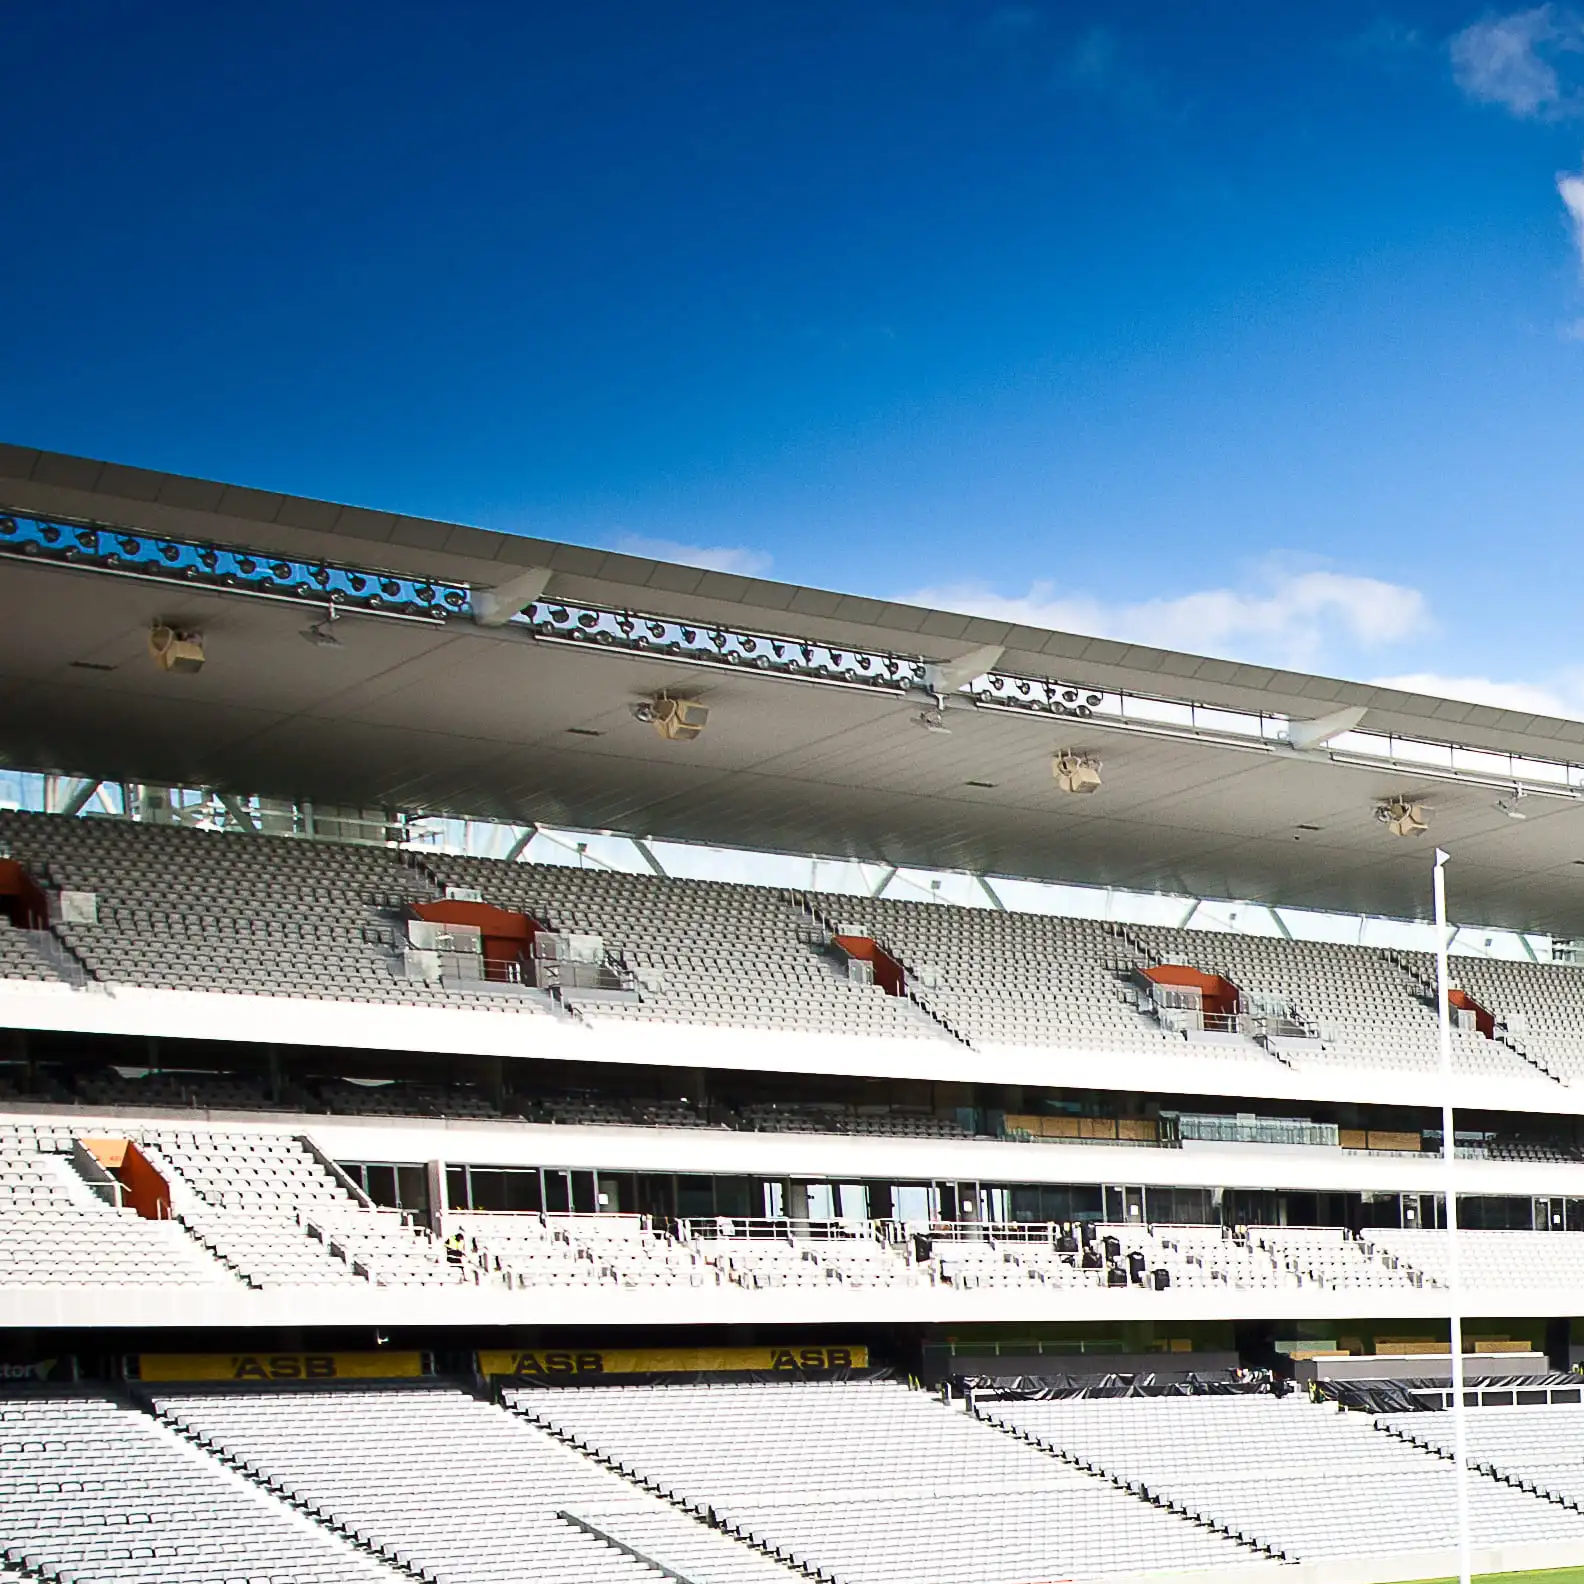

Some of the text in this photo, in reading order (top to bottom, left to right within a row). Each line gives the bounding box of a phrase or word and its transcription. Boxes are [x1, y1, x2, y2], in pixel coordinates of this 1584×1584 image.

[232, 1356, 337, 1378] ASB
[512, 1353, 604, 1375] ASB
[770, 1350, 851, 1370] ASB
